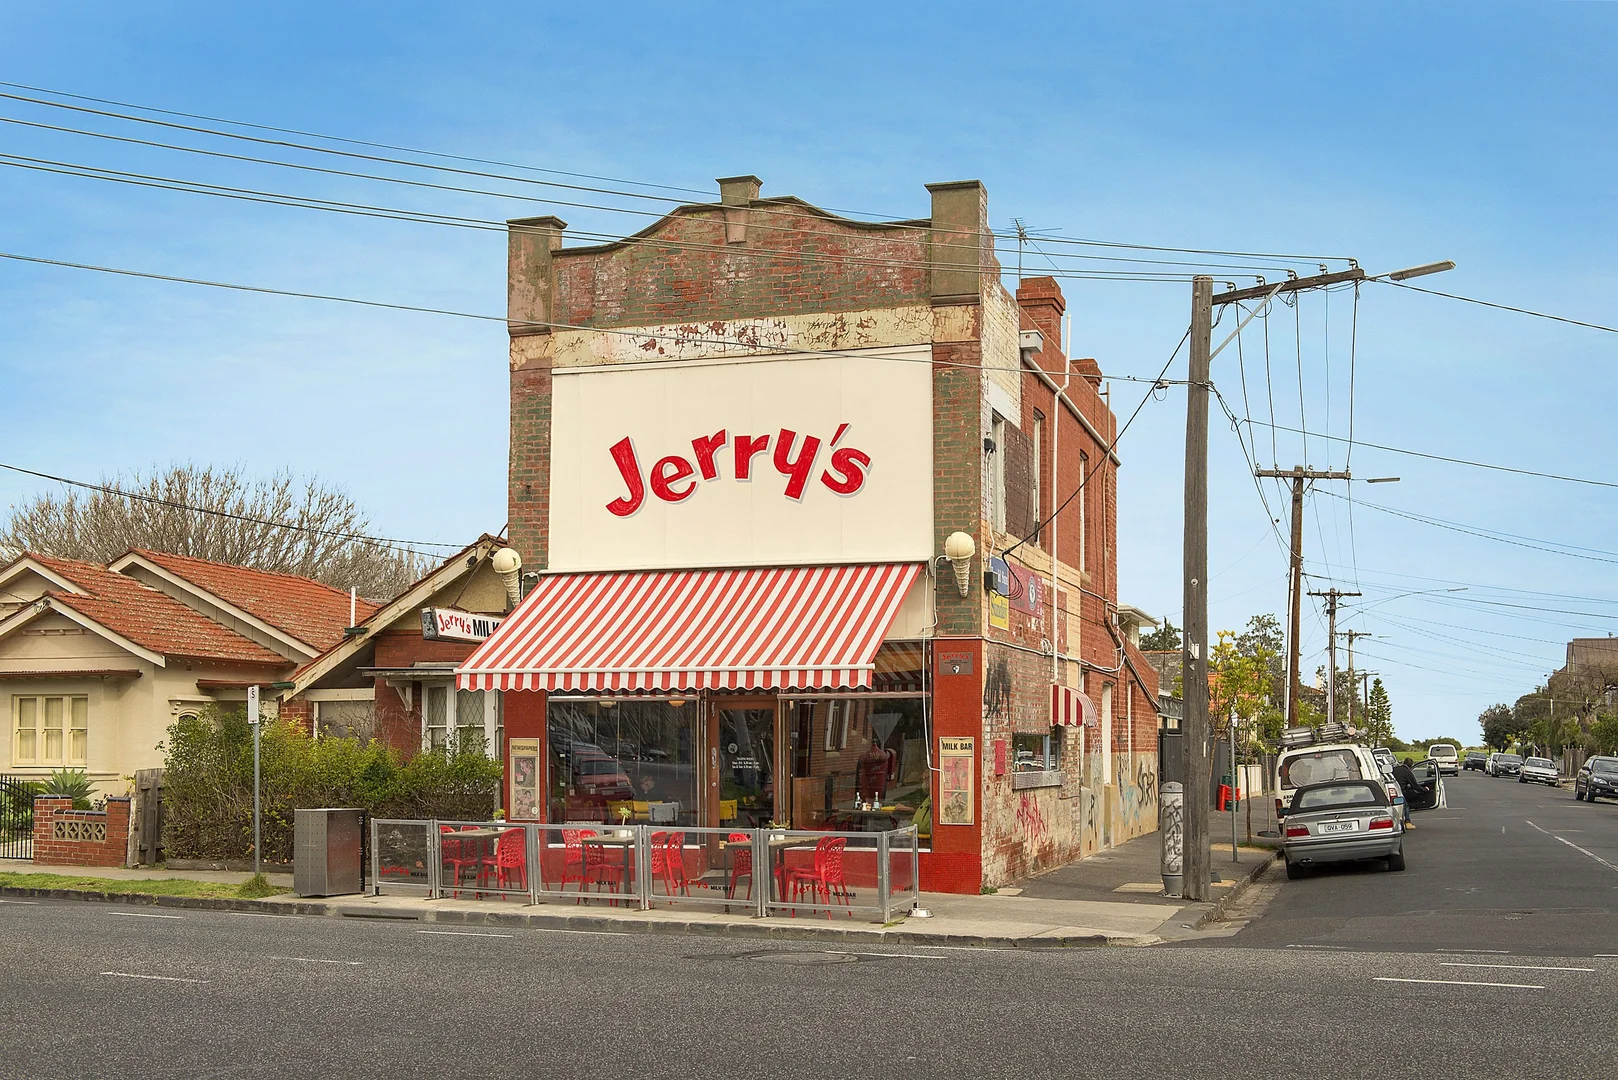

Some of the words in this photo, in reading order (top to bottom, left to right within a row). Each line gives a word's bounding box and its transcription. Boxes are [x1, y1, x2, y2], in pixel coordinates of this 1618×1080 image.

[605, 422, 873, 518] Jerry's
[438, 613, 472, 635] Jerry's
[942, 742, 958, 751] MILK
[960, 742, 973, 751] BAR
